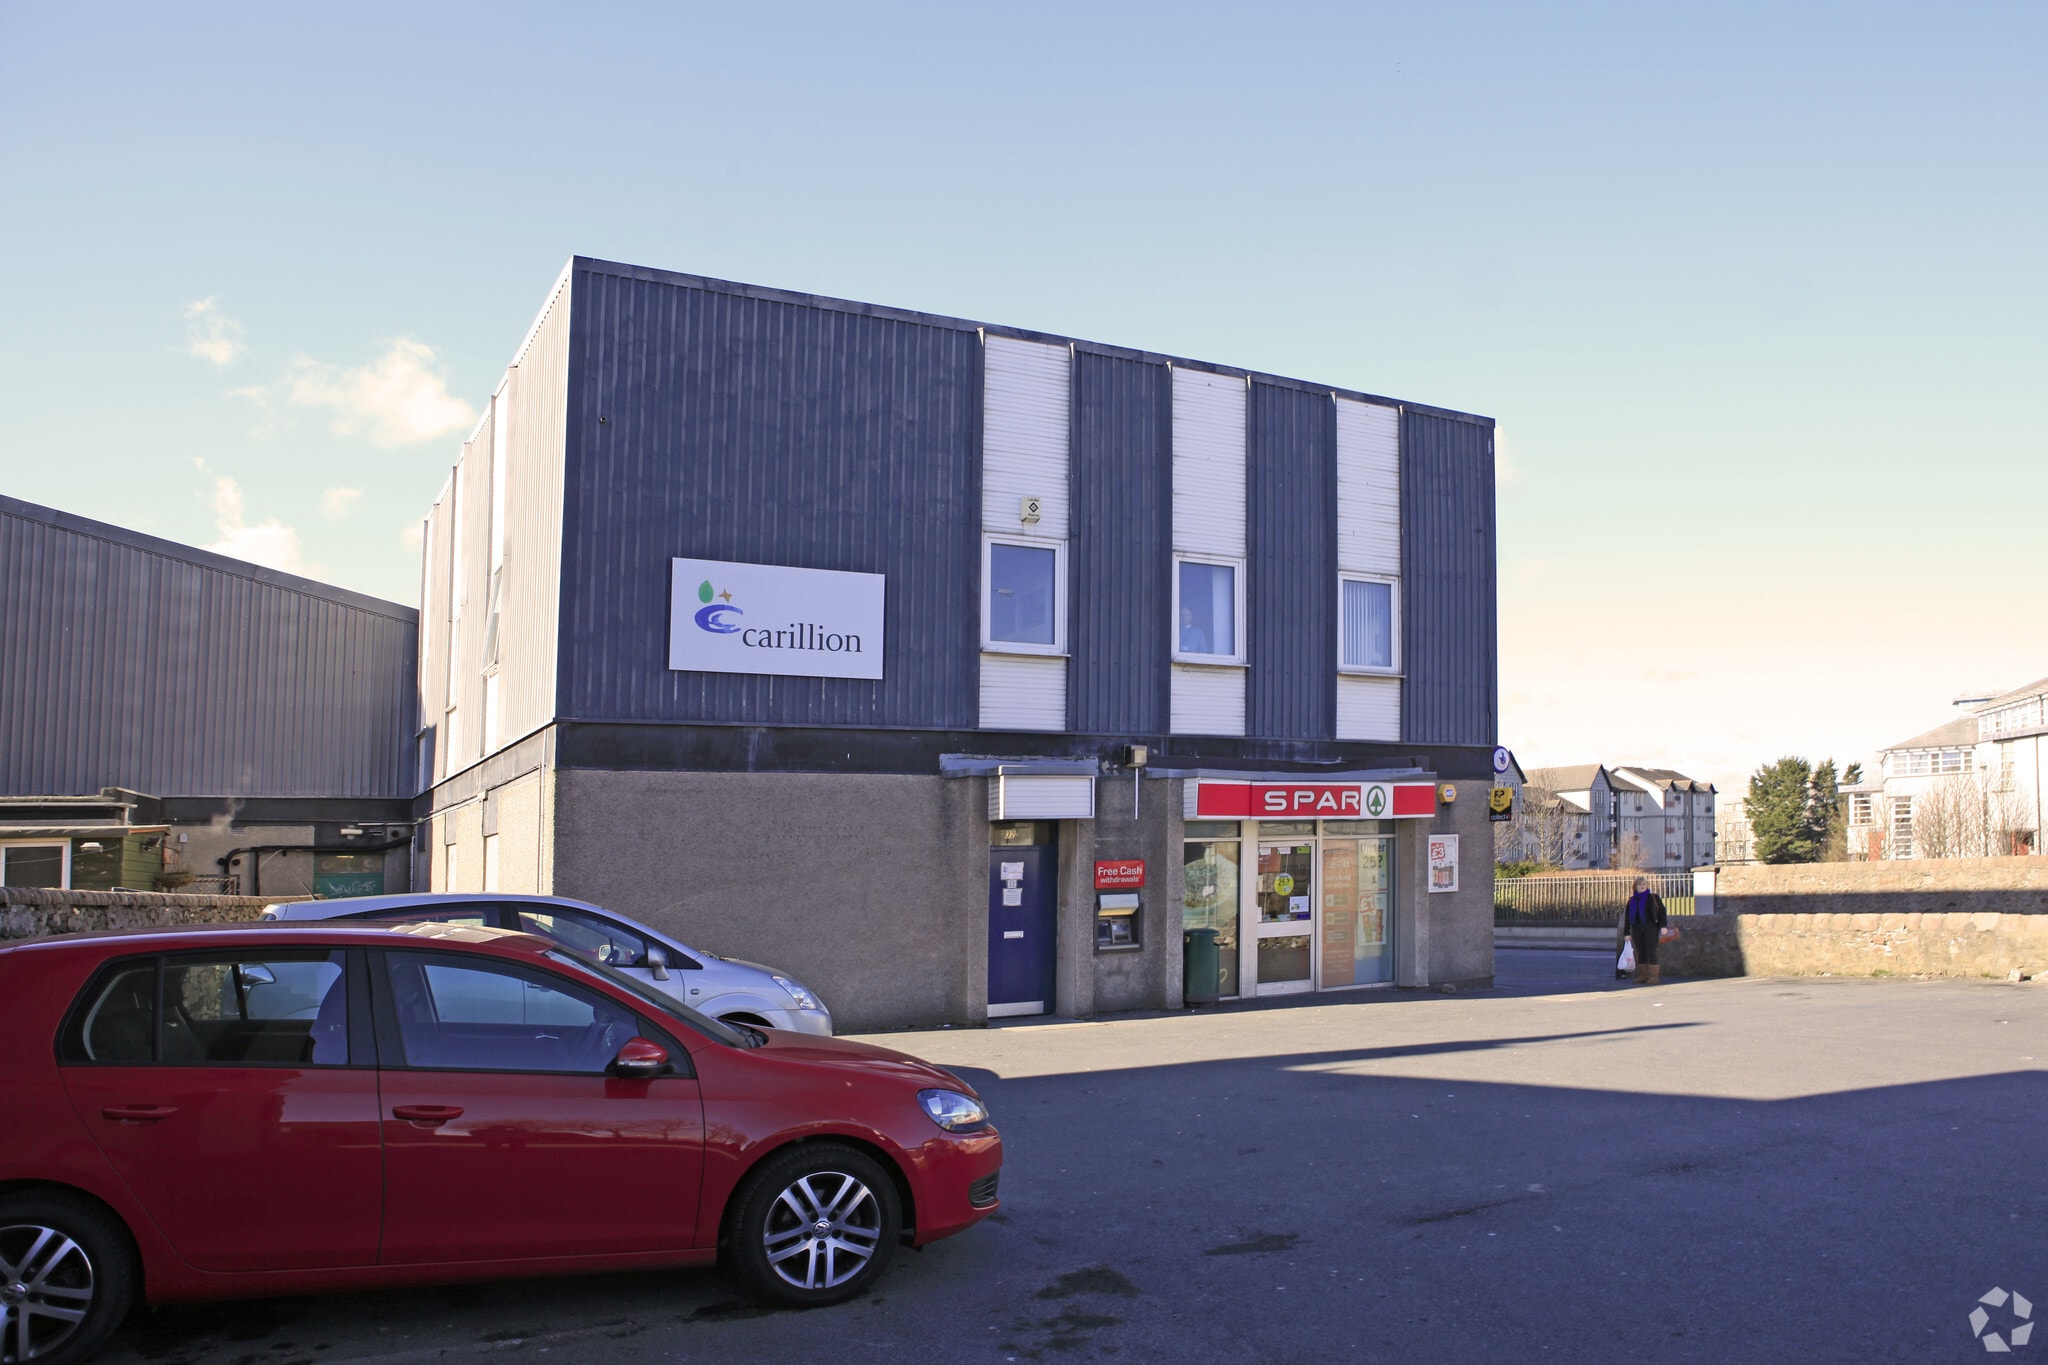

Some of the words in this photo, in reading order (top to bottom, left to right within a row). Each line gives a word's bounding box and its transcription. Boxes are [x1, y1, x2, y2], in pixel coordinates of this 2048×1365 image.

[742, 623, 862, 652] carillion
[1264, 790, 1359, 811] SPAR
[1361, 843, 1385, 852] Under
[1431, 847, 1445, 859] £3
[1363, 855, 1382, 868] 25?
[1098, 866, 1118, 876] Free
[1120, 866, 1142, 875] Cash
[1278, 878, 1290, 886] 25?
